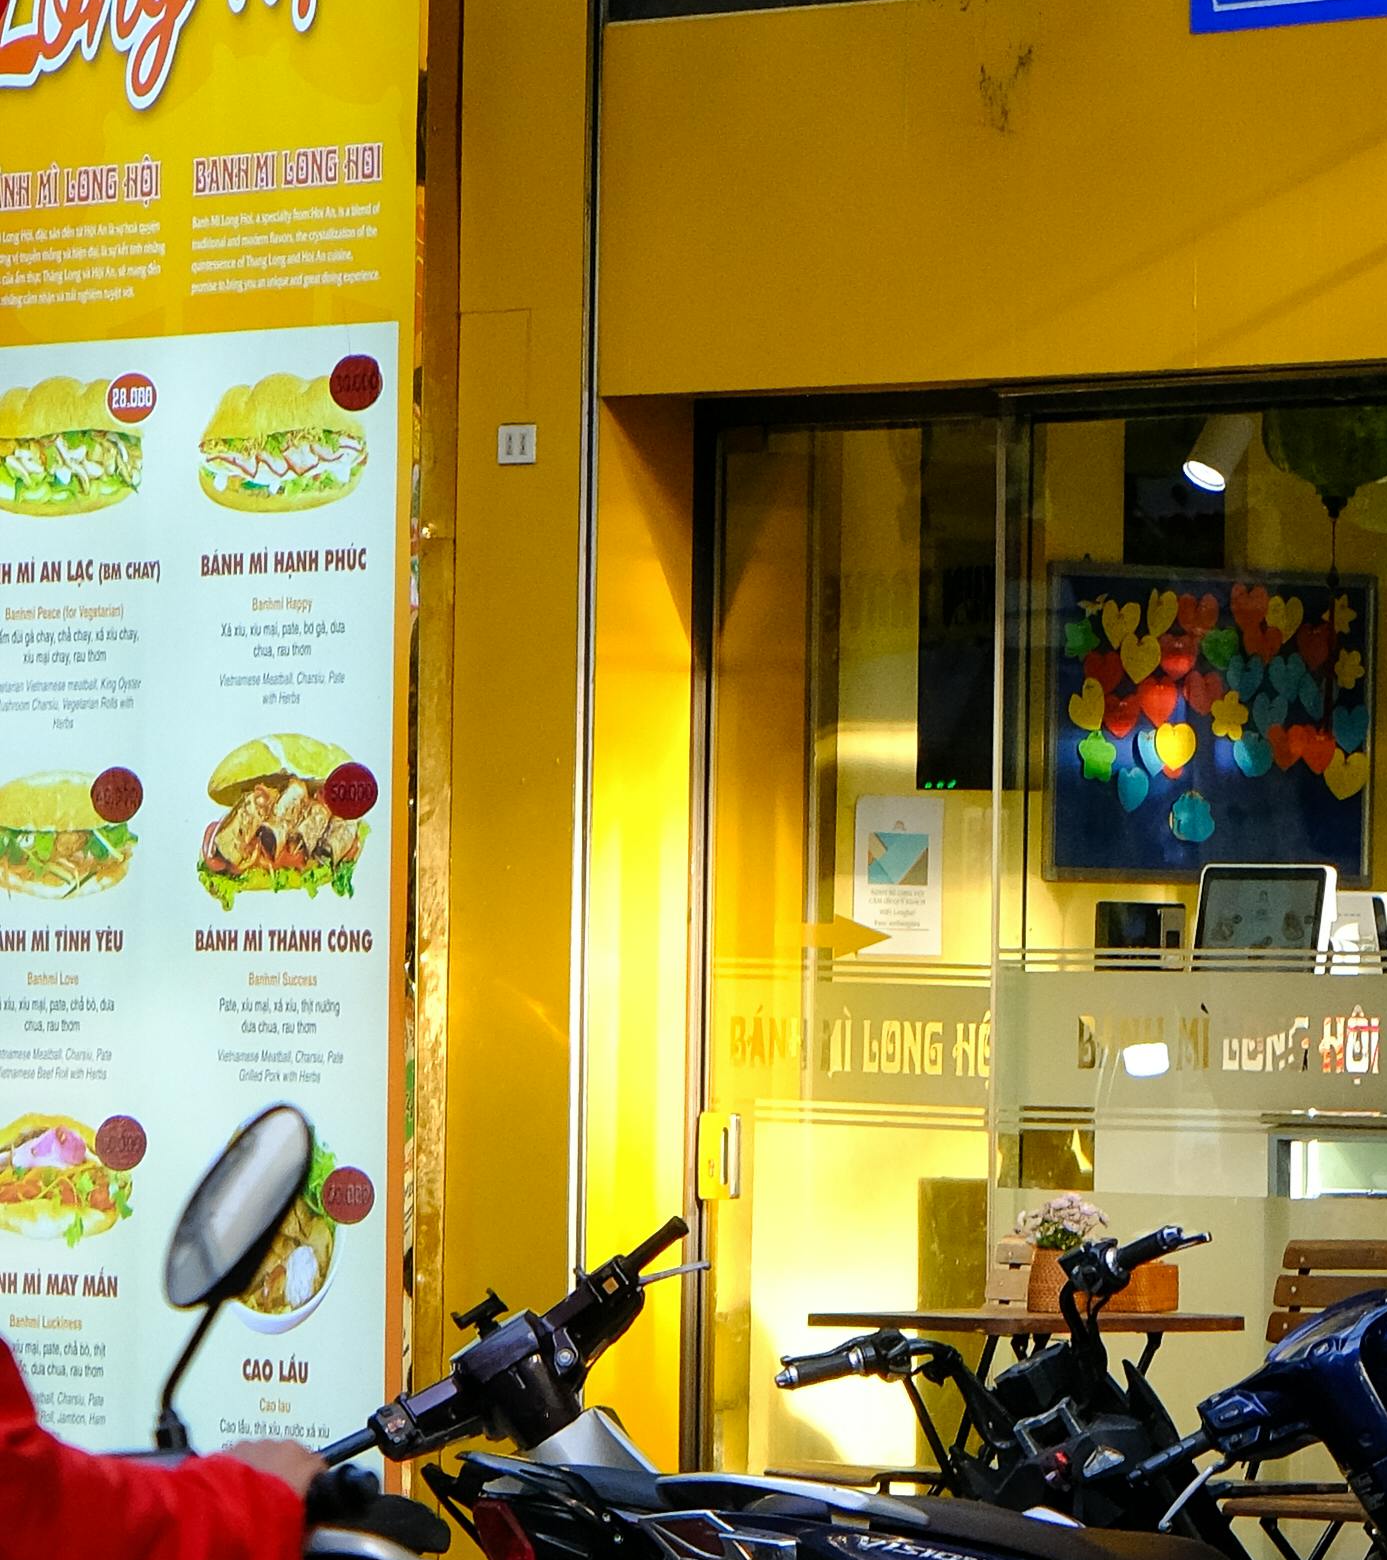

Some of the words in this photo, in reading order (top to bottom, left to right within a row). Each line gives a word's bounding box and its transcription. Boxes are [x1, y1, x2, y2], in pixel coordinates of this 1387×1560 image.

[282, 146, 338, 187] LONG
[36, 161, 60, 208] MÌ
[64, 165, 118, 206] LONG
[122, 154, 161, 208] HỘI
[112, 385, 153, 411] 28.000
[17, 556, 35, 583] MÌ
[40, 561, 61, 583] AN
[67, 559, 94, 587] LẠC
[99, 561, 121, 585] (BM
[126, 560, 160, 583] CHAY)
[201, 549, 243, 576] BÁNH
[249, 547, 268, 574] MÌ
[274, 550, 318, 579] HẠNH
[325, 543, 367, 571] PHÚC
[286, 598, 312, 612] Happy
[31, 925, 49, 952] MÌ
[55, 925, 90, 952] TÌNH
[96, 926, 123, 952] YÊU
[195, 925, 238, 951] BÁNH
[243, 924, 262, 952] MÌ
[268, 924, 321, 952] THÀNH
[328, 924, 373, 952] CÔNG
[863, 1020, 943, 1074] LONG
[1319, 1005, 1380, 1084] HỘI
[23, 1269, 41, 1295] MÌ
[46, 1273, 78, 1296] MAY
[243, 1358, 273, 1382] CAO
[260, 1398, 276, 1413] Cao
